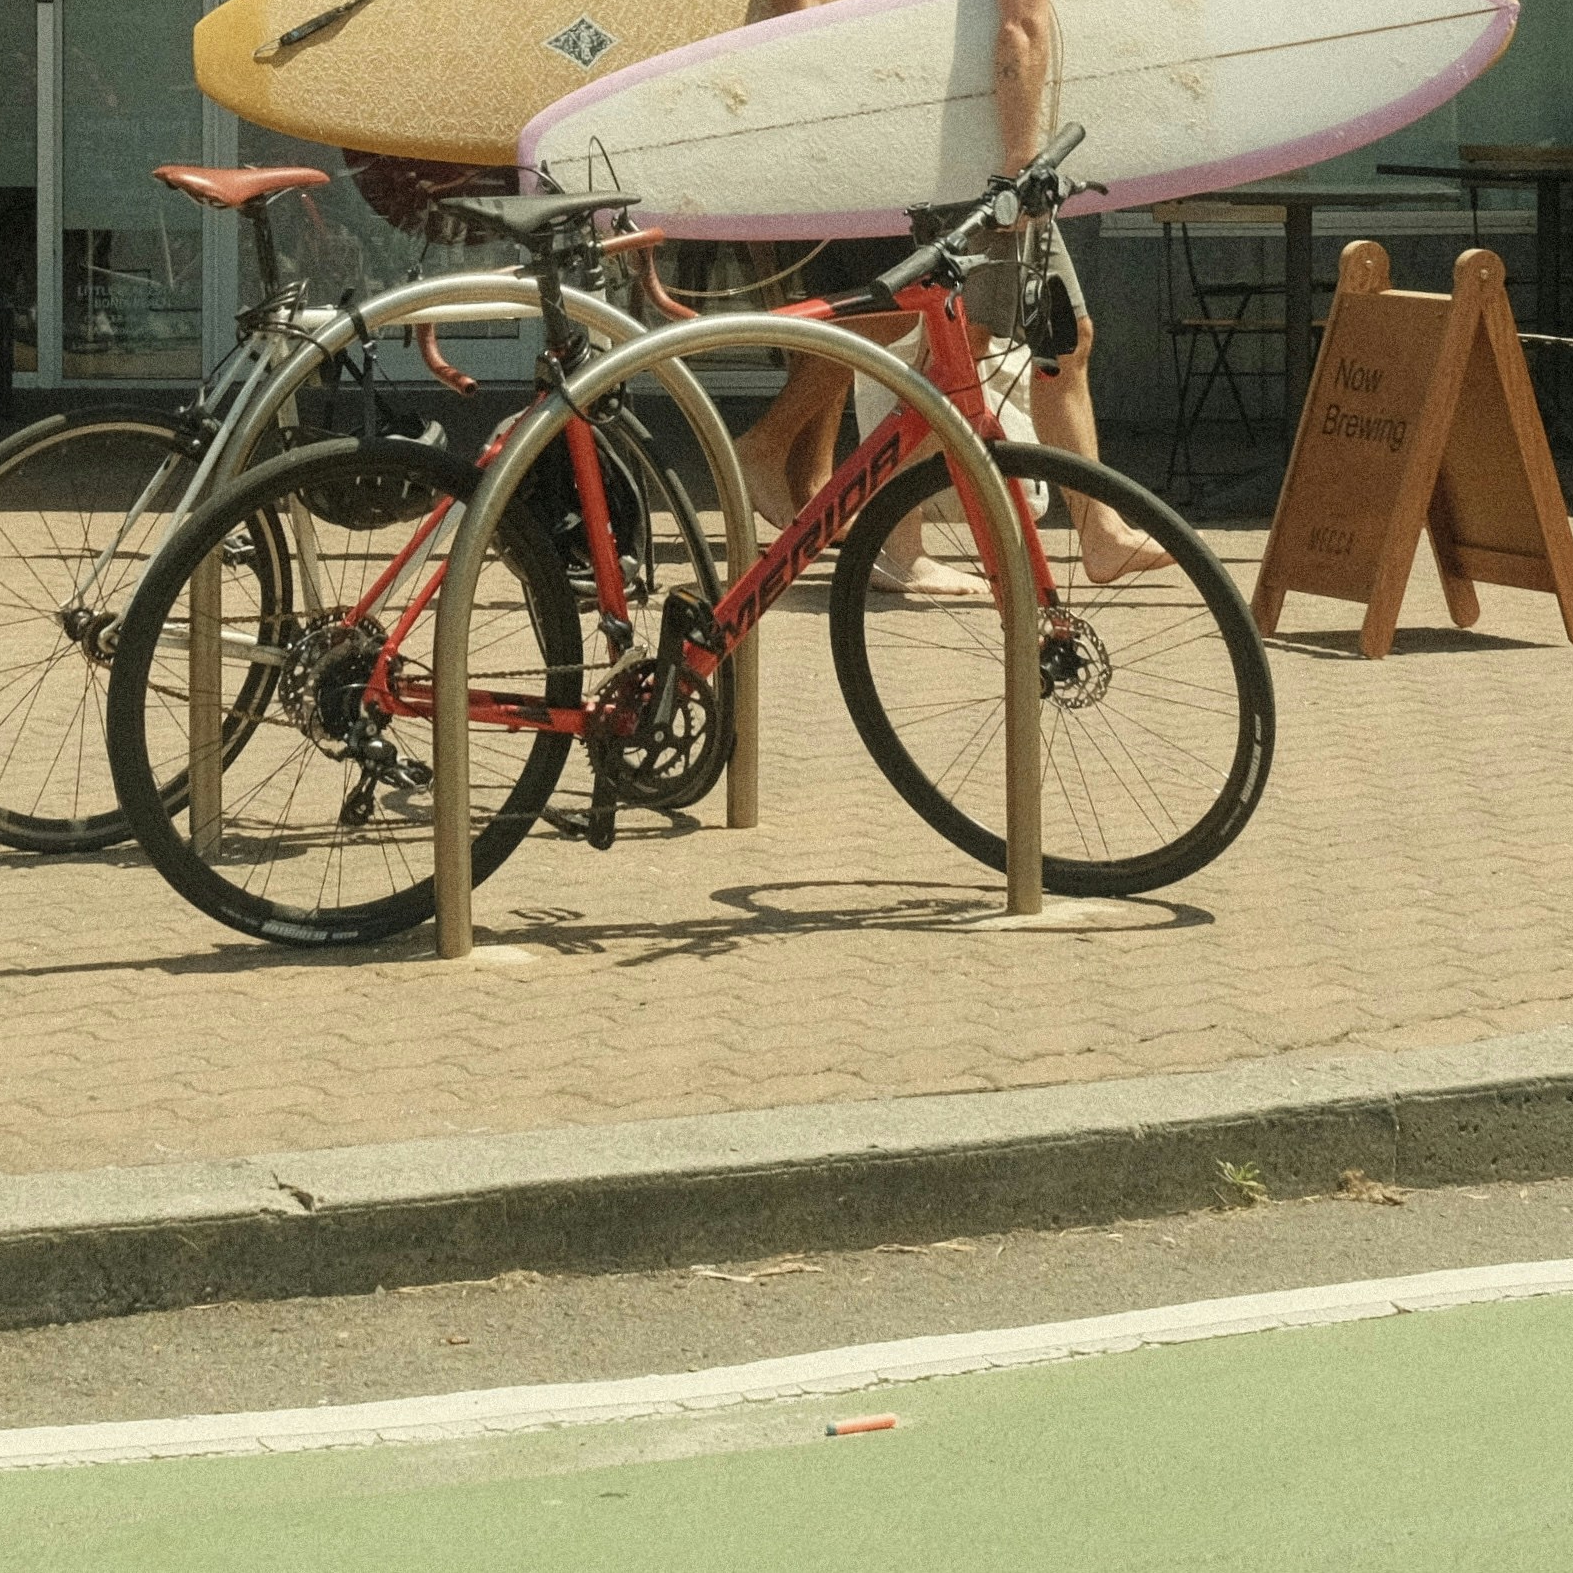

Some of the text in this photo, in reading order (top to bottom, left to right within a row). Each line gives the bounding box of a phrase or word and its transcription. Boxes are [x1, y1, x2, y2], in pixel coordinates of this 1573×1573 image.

[1334, 357, 1384, 393] Now
[1322, 403, 1407, 453] Brewing
[723, 431, 900, 639] MERIDA
